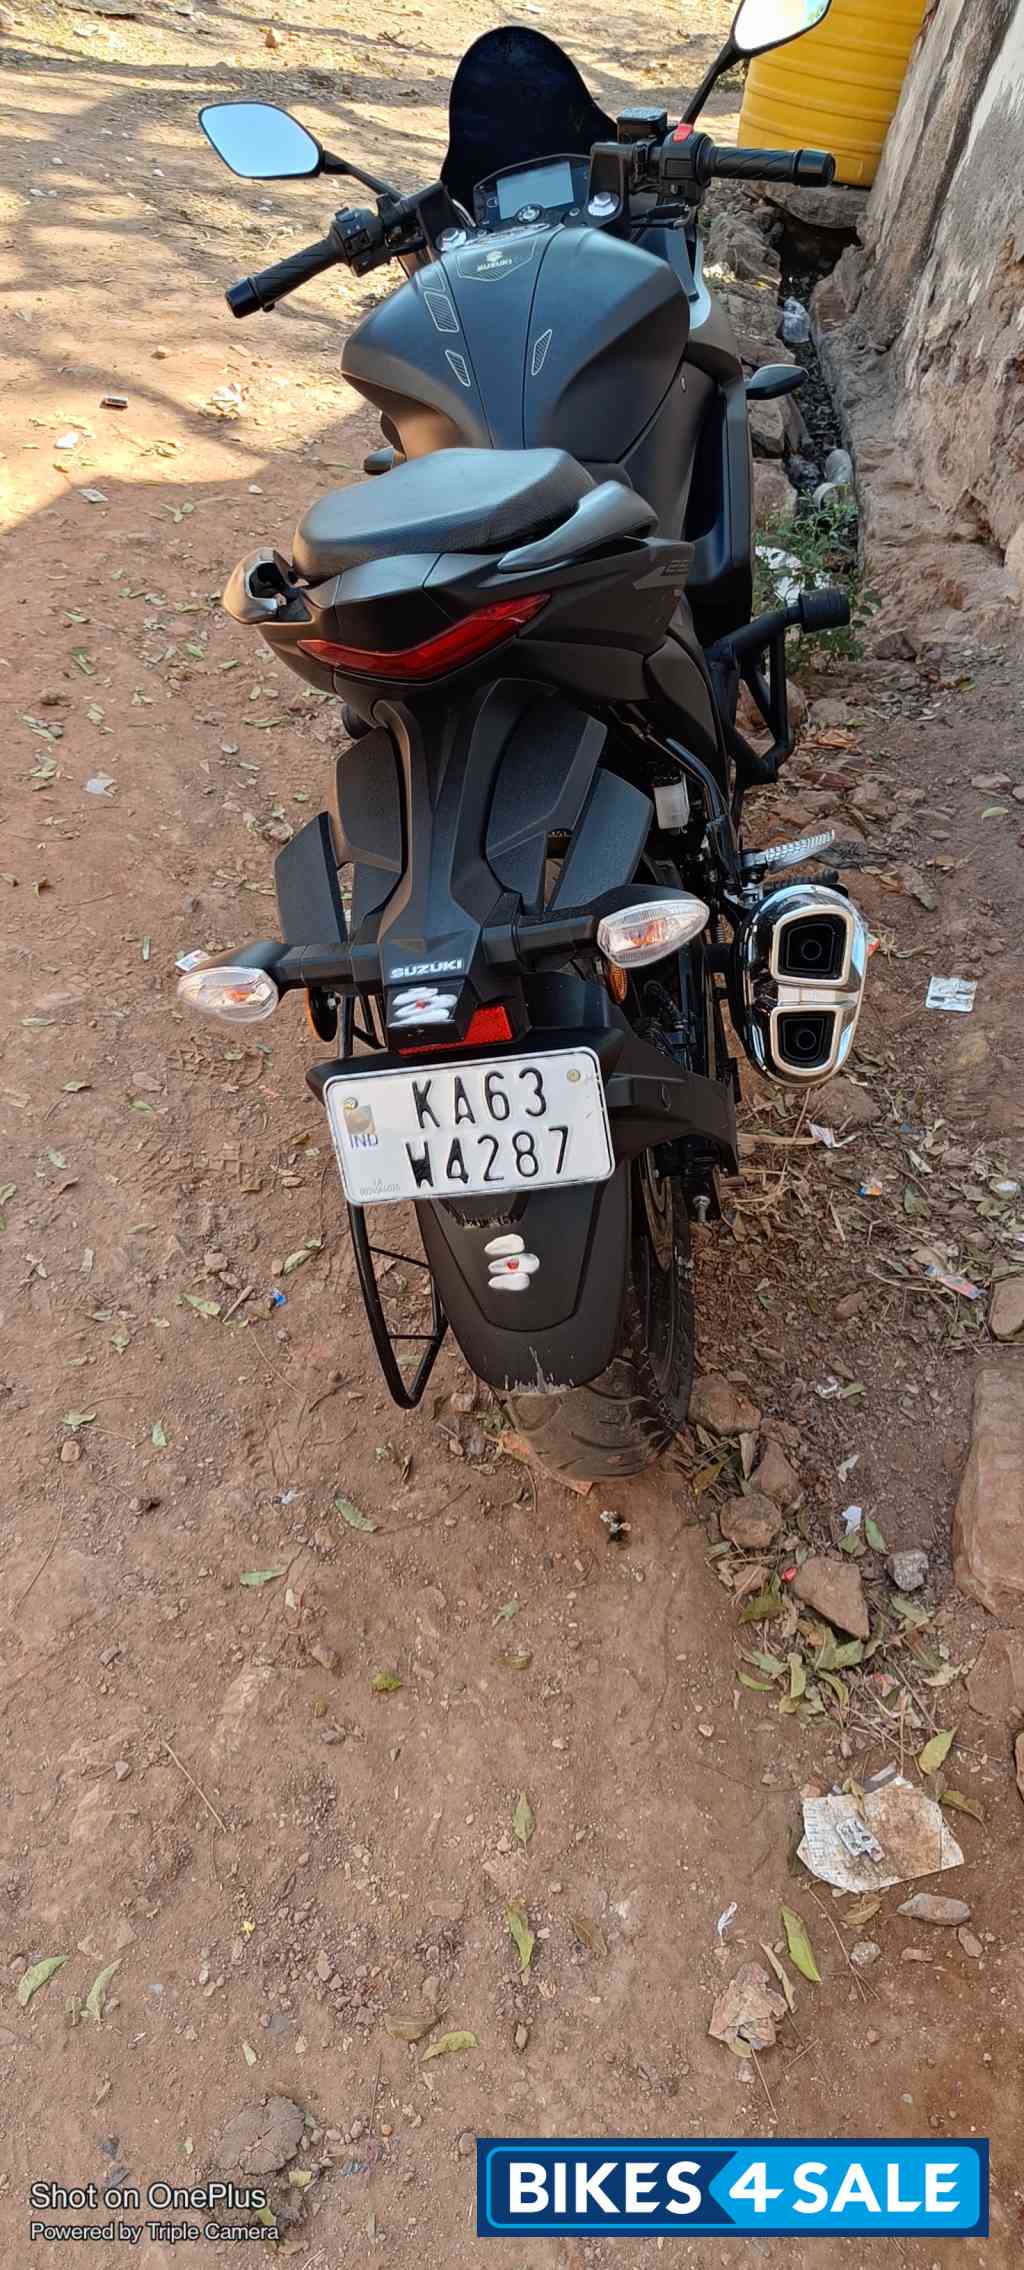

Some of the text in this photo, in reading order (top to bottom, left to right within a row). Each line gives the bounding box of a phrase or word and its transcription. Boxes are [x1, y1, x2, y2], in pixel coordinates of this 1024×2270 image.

[390, 960, 463, 979] SUZUKI
[411, 1067, 547, 1129] KA63
[350, 1133, 378, 1148] IND
[405, 1125, 569, 1188] W4287
